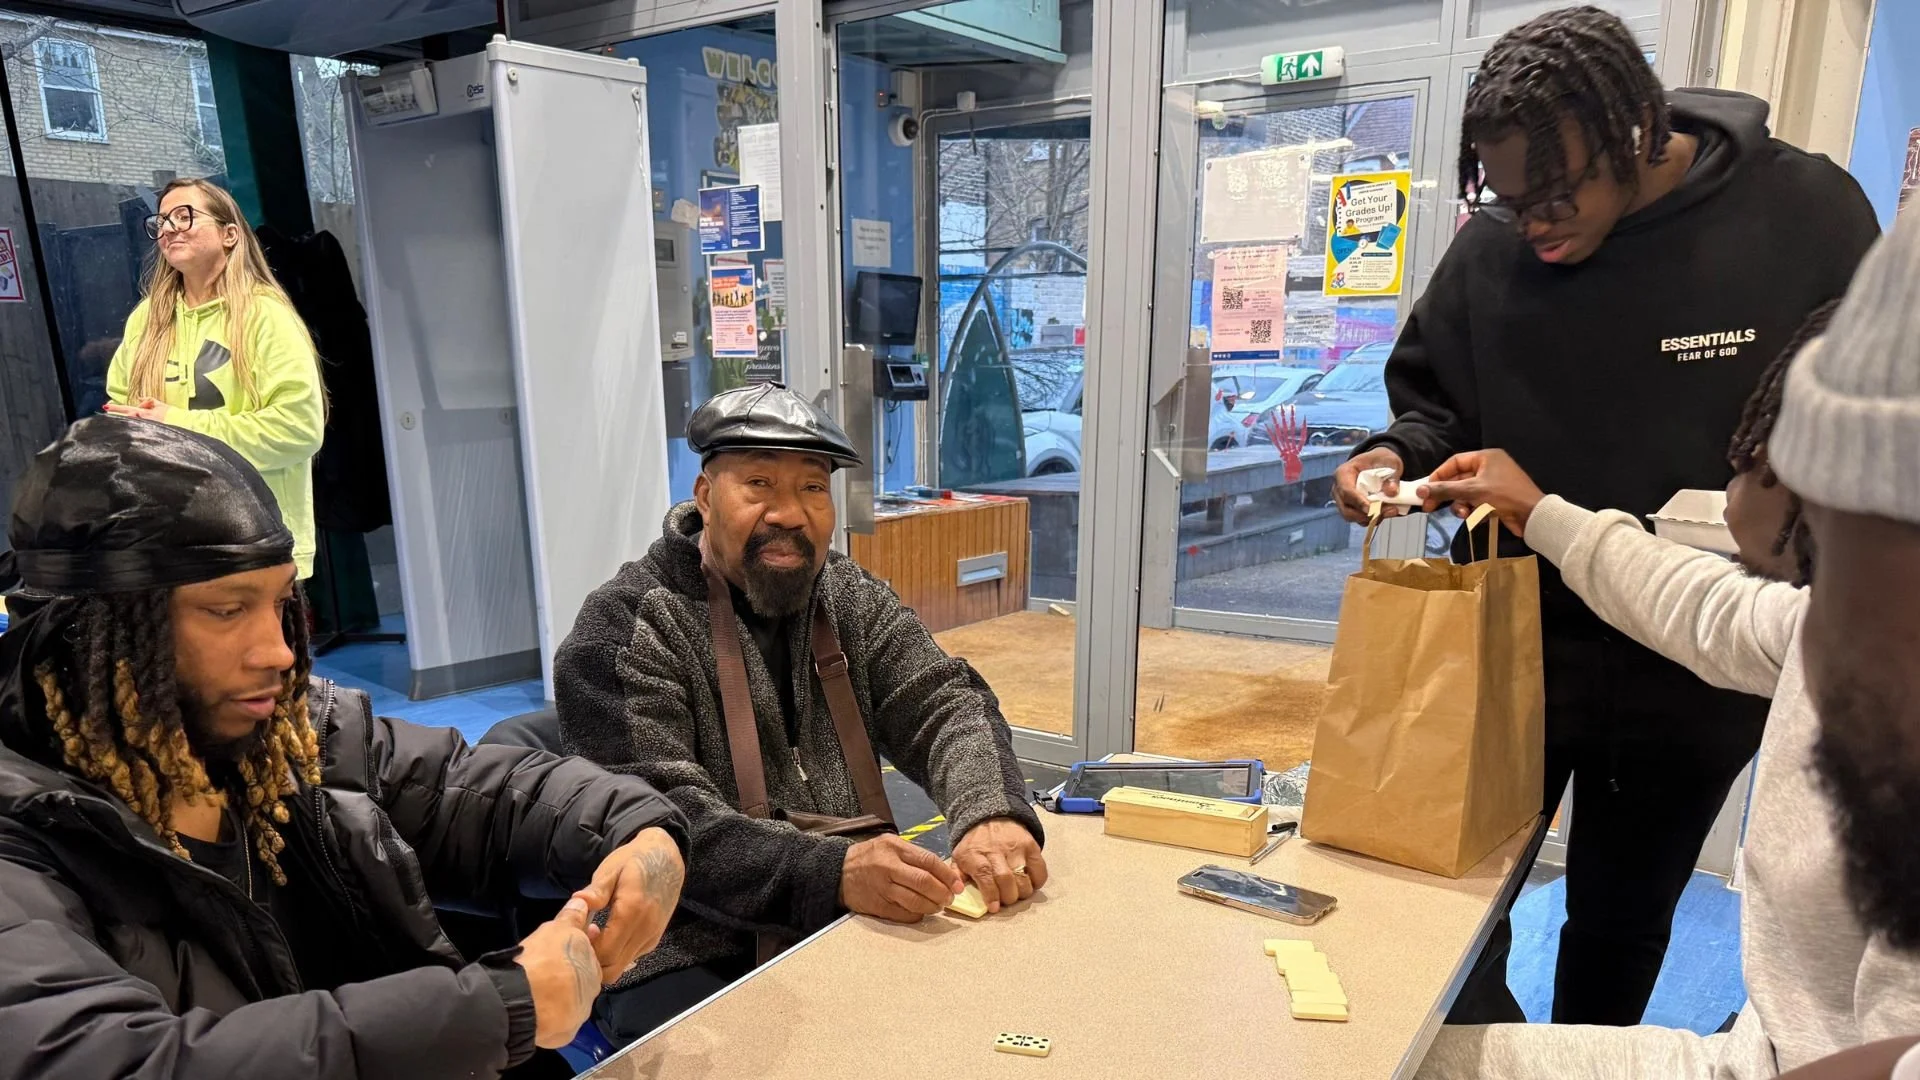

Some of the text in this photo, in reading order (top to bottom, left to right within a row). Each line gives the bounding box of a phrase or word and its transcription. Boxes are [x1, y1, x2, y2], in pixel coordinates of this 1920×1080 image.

[1351, 195, 1388, 207] Get Your
[1345, 203, 1393, 218] Grades Up!
[1355, 215, 1384, 224] Program
[1661, 328, 1756, 352] ESSENTIALS
[1677, 346, 1738, 362] FEAR OF GOD
